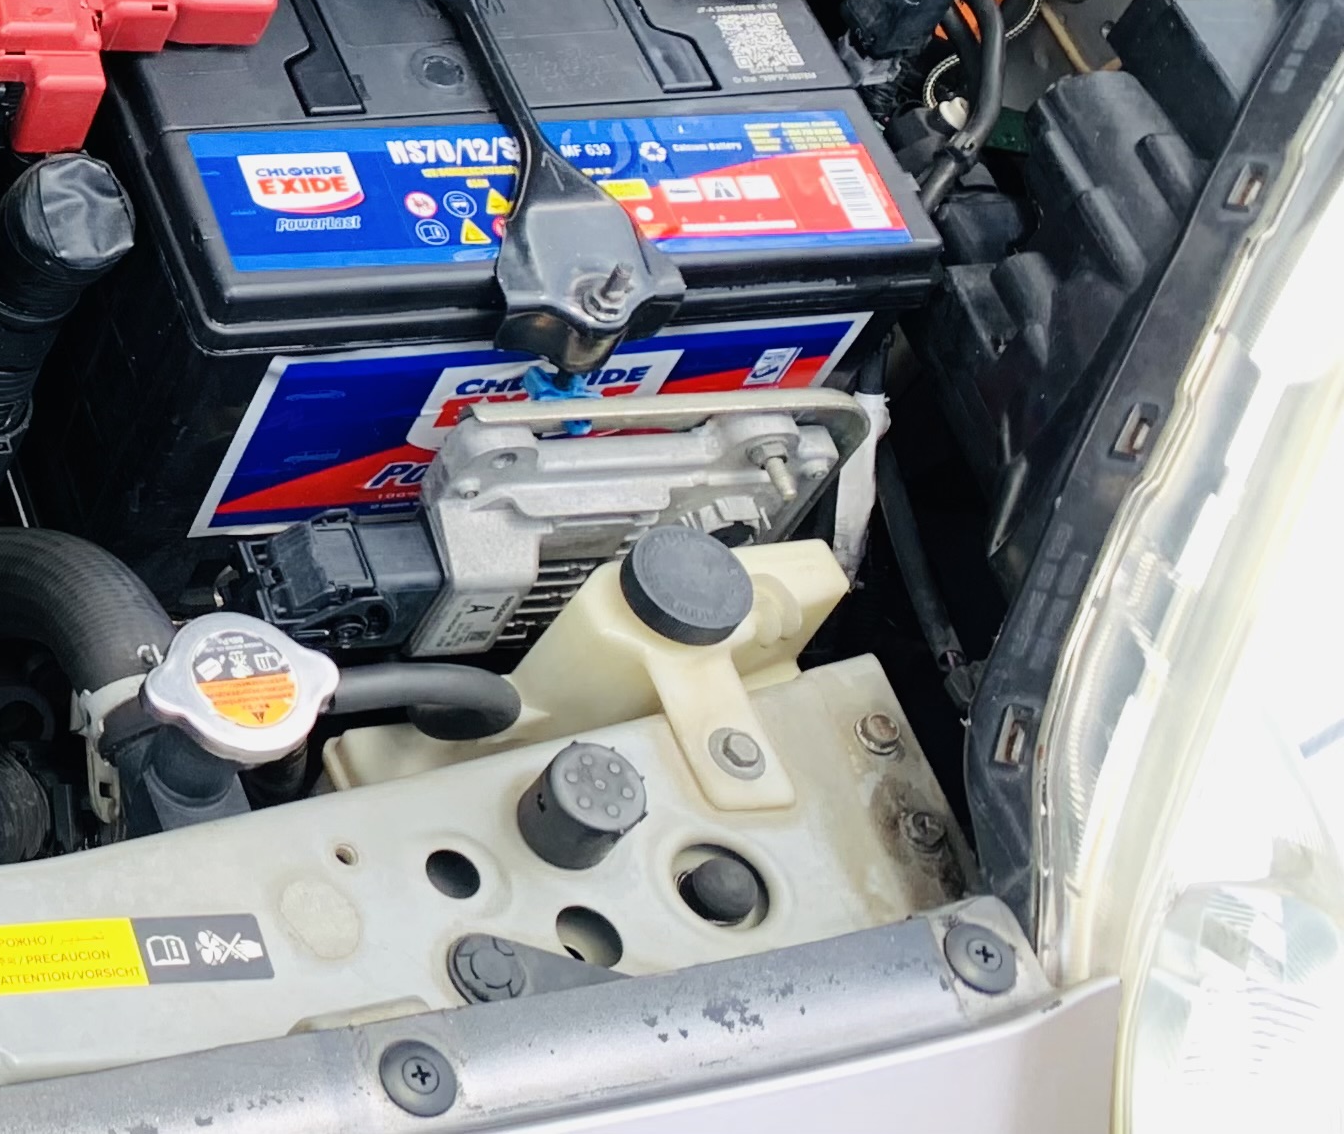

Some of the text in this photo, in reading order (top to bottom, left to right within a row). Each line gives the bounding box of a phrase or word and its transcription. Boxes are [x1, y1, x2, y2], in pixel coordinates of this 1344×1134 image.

[561, 142, 612, 158] MF 639
[255, 166, 343, 177] CHLORIDE
[257, 176, 350, 195] EXIDE
